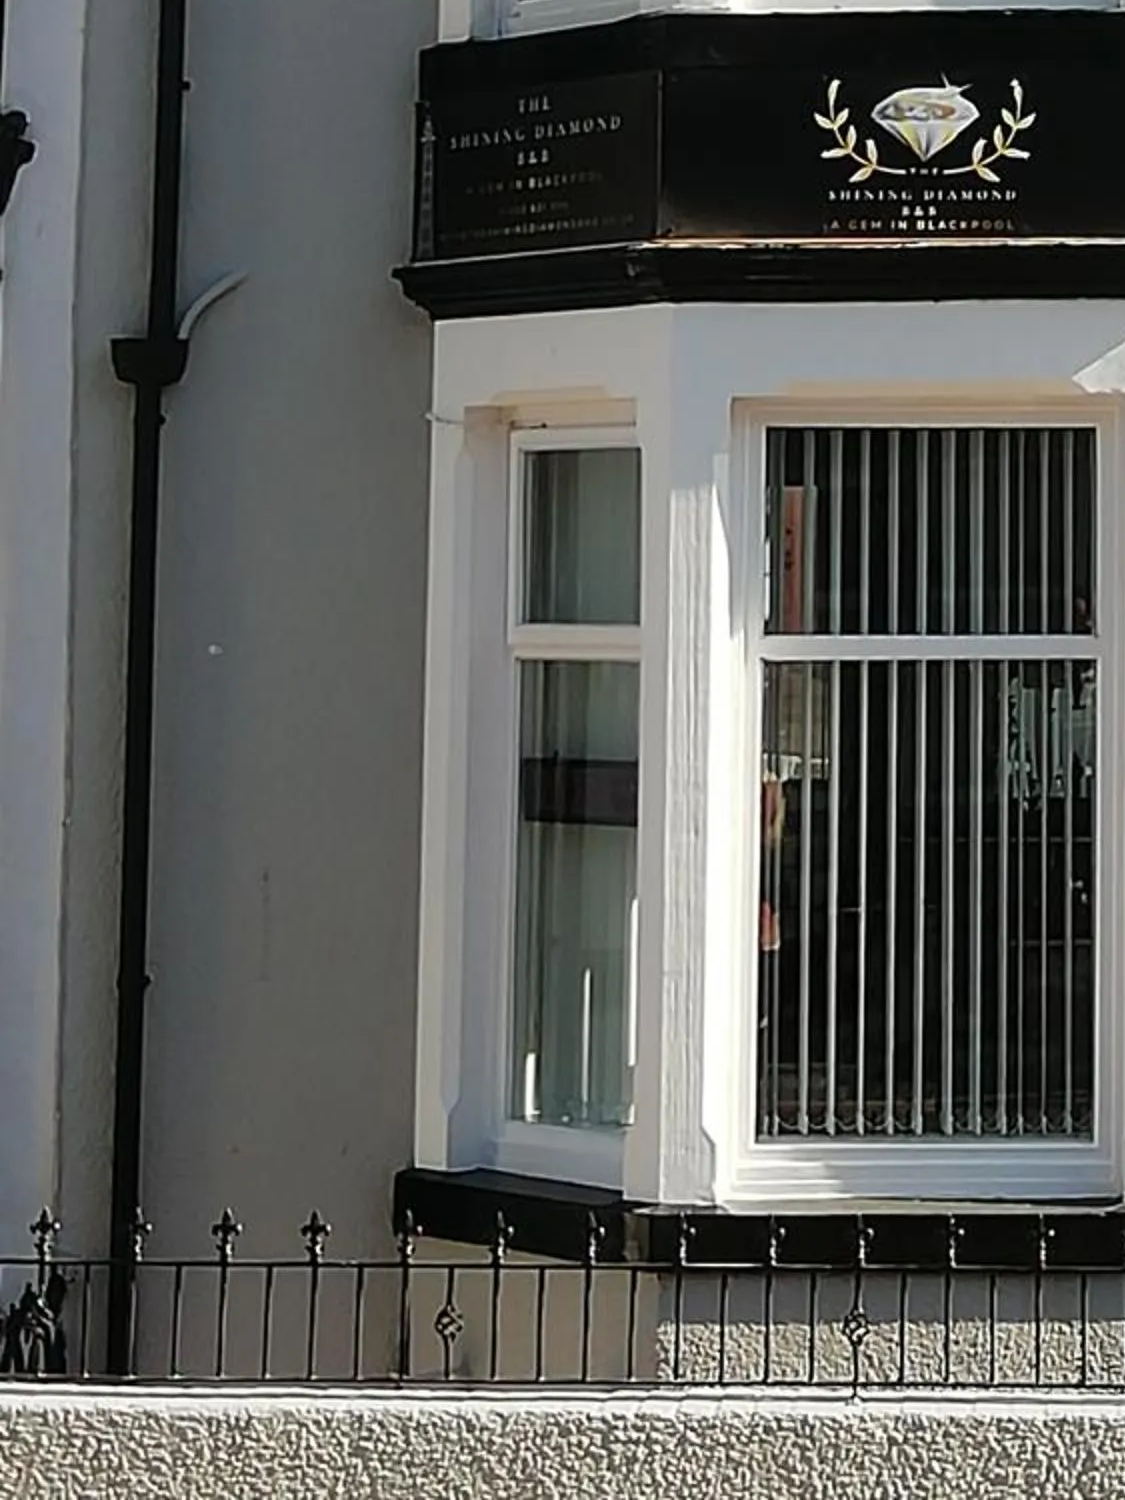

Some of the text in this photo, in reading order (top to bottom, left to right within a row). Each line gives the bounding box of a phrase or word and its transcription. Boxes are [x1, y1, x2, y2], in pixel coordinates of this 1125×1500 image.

[450, 115, 622, 150] SHINING DIAMOND
[828, 189, 1017, 201] SHINING DIAMOND
[901, 205, 938, 217] B&B
[849, 219, 883, 230] GEM
[890, 219, 908, 230] IN
[916, 219, 1015, 231] BLACKPOOL
